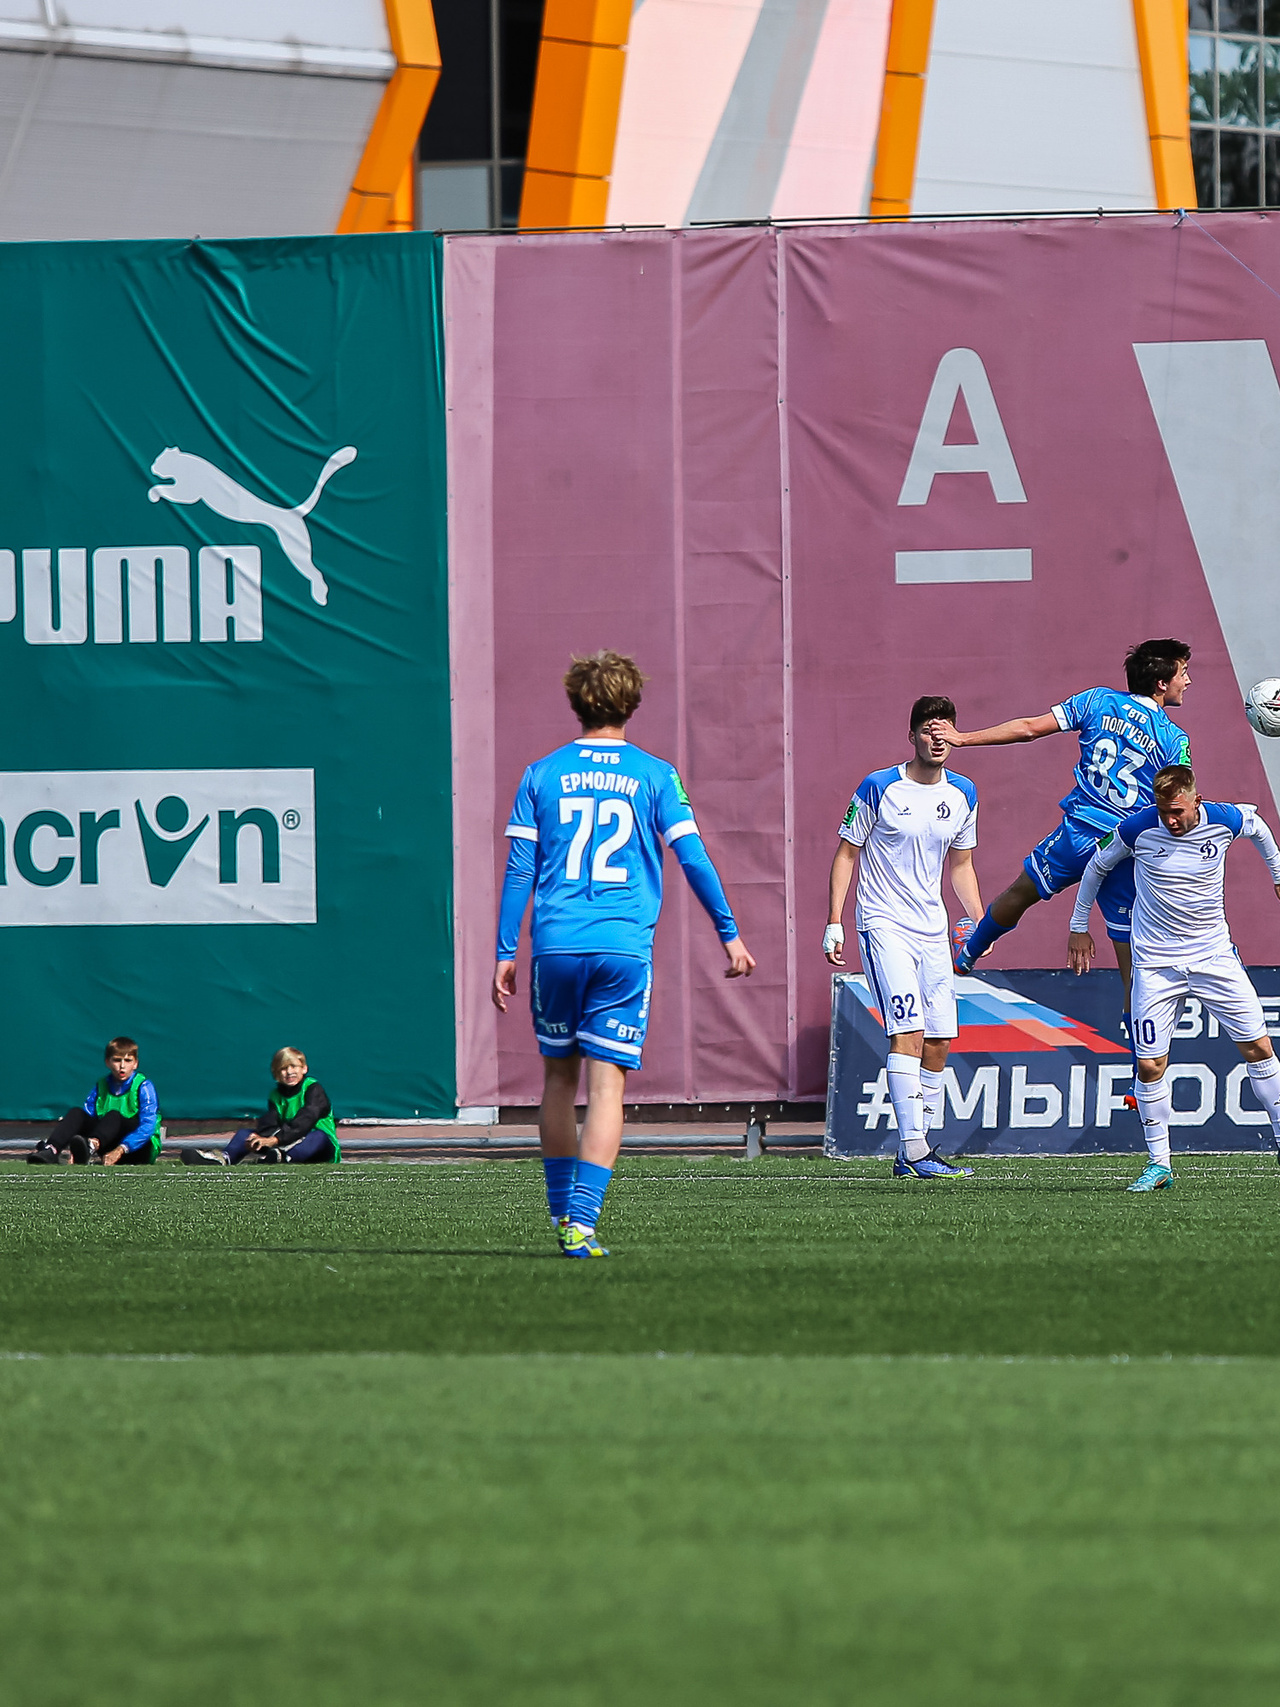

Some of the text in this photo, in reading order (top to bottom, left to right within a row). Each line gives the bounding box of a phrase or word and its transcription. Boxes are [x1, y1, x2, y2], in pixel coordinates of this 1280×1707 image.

[0, 545, 263, 645] UMA
[1127, 708, 1149, 725] ВТБ
[1101, 715, 1157, 754] ПОДГУЗОВ
[591, 752, 621, 764] ВТБ
[560, 771, 640, 797] ЕРМОЛИН
[1087, 738, 1147, 808] 83
[558, 797, 634, 882] 72
[890, 993, 918, 1021] 32
[616, 1023, 642, 1041] ВТБ
[1133, 1018, 1156, 1045] 10
